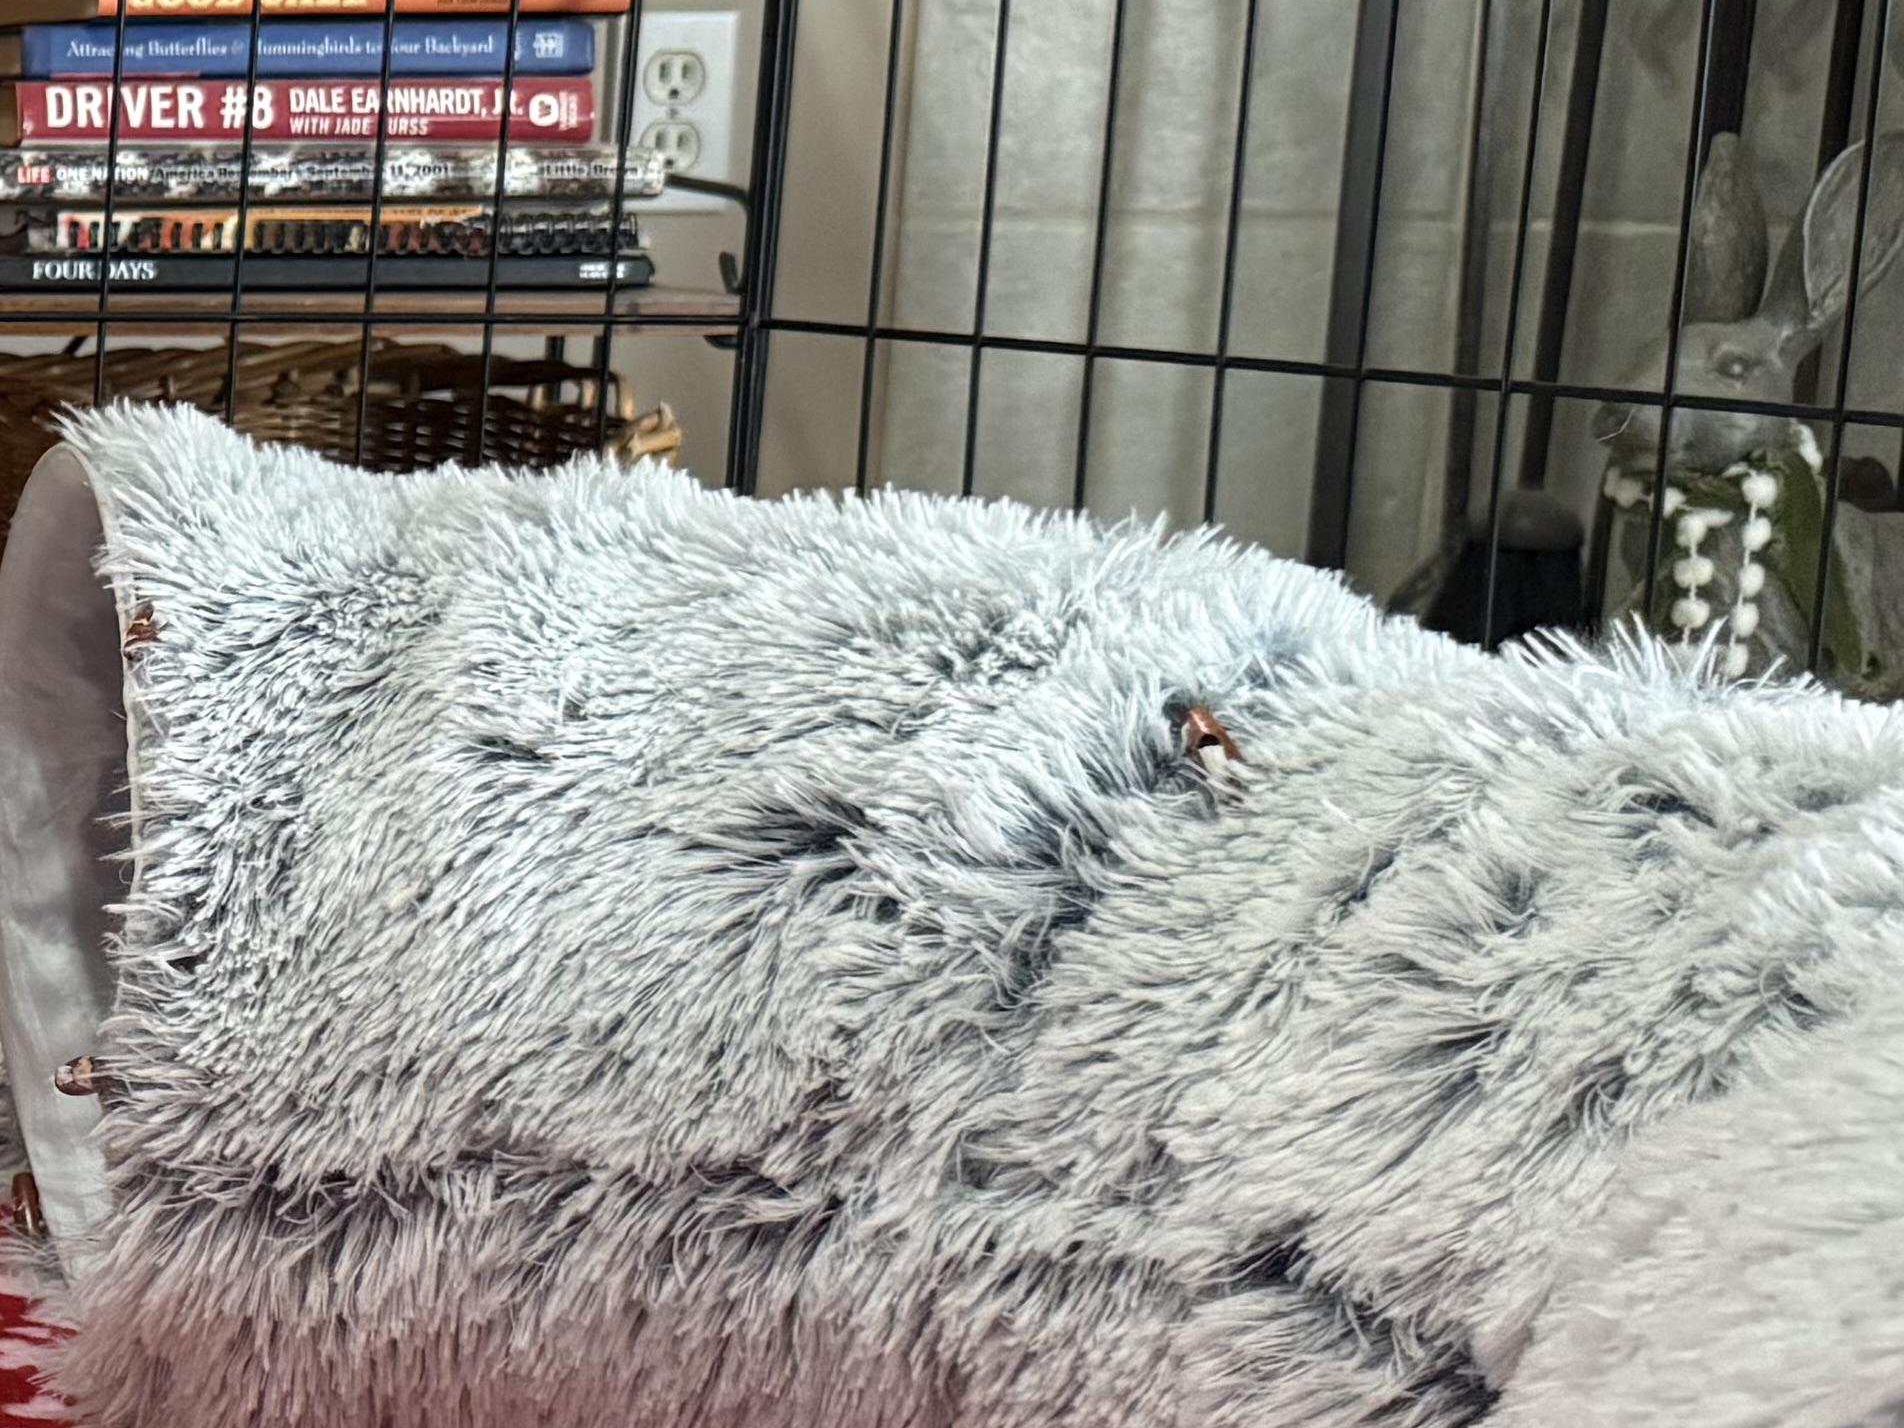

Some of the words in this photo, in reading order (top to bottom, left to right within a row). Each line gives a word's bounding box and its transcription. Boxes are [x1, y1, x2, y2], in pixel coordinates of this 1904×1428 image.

[67, 40, 143, 59] Attracng
[148, 35, 227, 58] Butterflies
[425, 35, 494, 57] Backyard
[45, 86, 205, 129] DRIVER
[221, 86, 274, 130] #8
[289, 87, 347, 114] DALE
[289, 117, 329, 136] WITH
[387, 117, 430, 136] URSS
[17, 166, 52, 185] LIFE
[56, 166, 90, 181] ONE
[306, 165, 372, 179] Septemb
[32, 260, 95, 280] FOUR
[97, 259, 158, 280] DAYS
